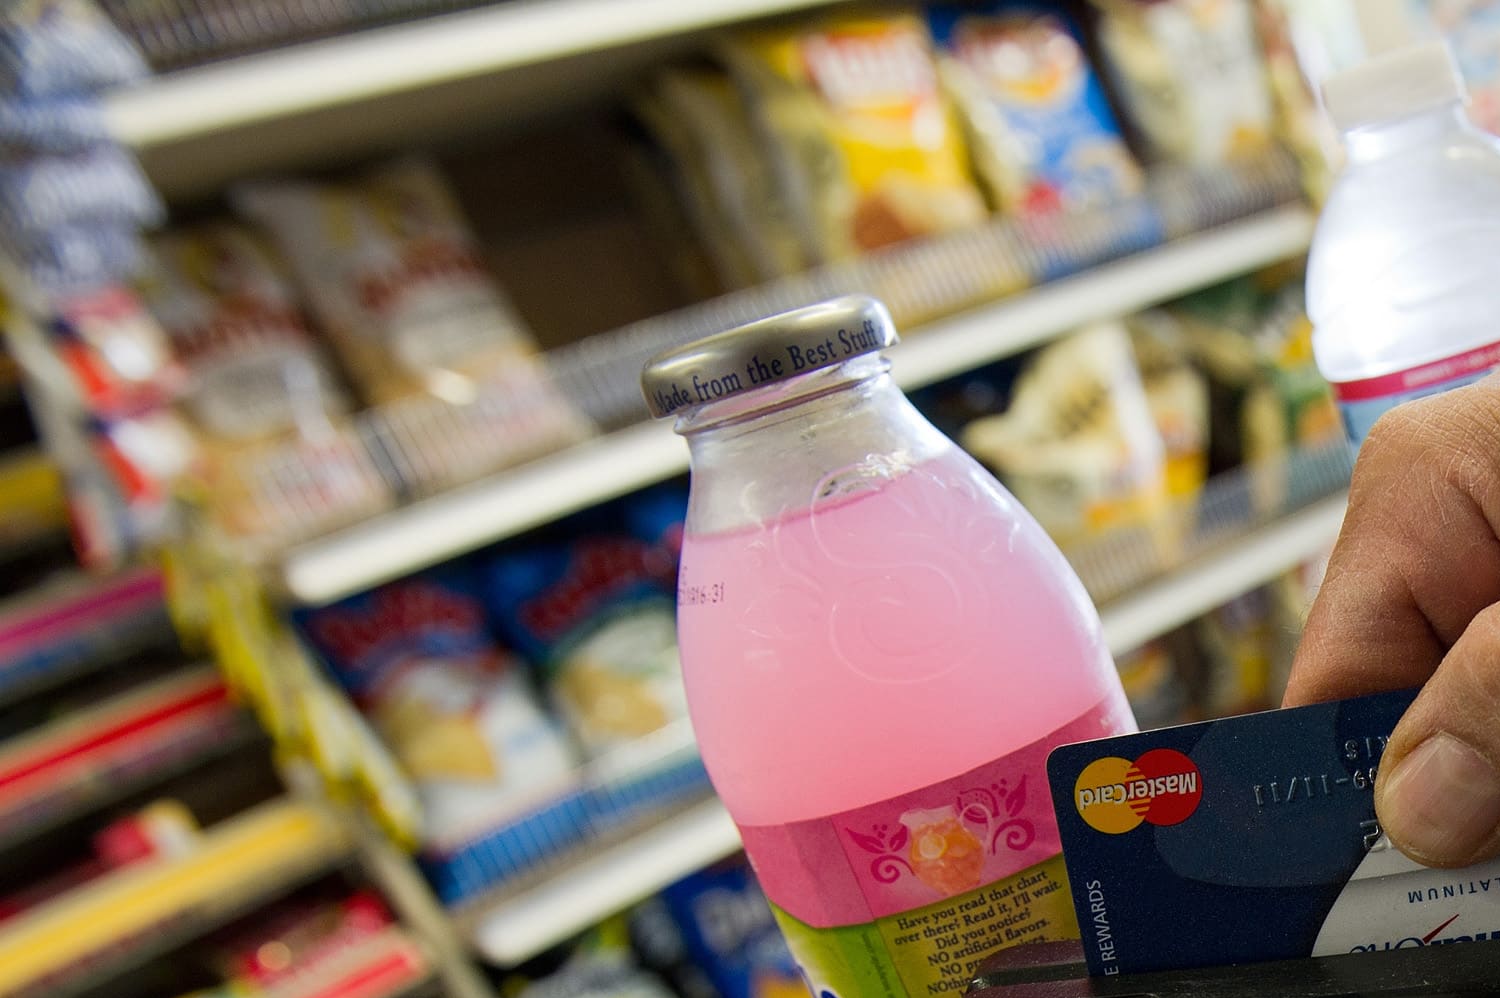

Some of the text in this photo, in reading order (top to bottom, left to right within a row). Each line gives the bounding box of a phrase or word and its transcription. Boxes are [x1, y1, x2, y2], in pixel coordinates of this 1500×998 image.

[692, 373, 744, 402] from
[747, 356, 784, 384] the
[786, 339, 836, 370] Best
[838, 320, 879, 355] Stuff
[1078, 771, 1198, 811] MasterCard
[894, 931, 921, 946] over
[963, 907, 995, 926] Read
[998, 900, 1012, 915] it,
[1014, 891, 1031, 908] I'll
[897, 871, 1048, 931] Have you read that chart
[1086, 879, 1116, 964] REWARDS
[927, 951, 950, 967] NO
[954, 934, 1004, 960] artificial
[936, 934, 959, 950] Did
[962, 926, 985, 945] you
[940, 962, 963, 978] NO
